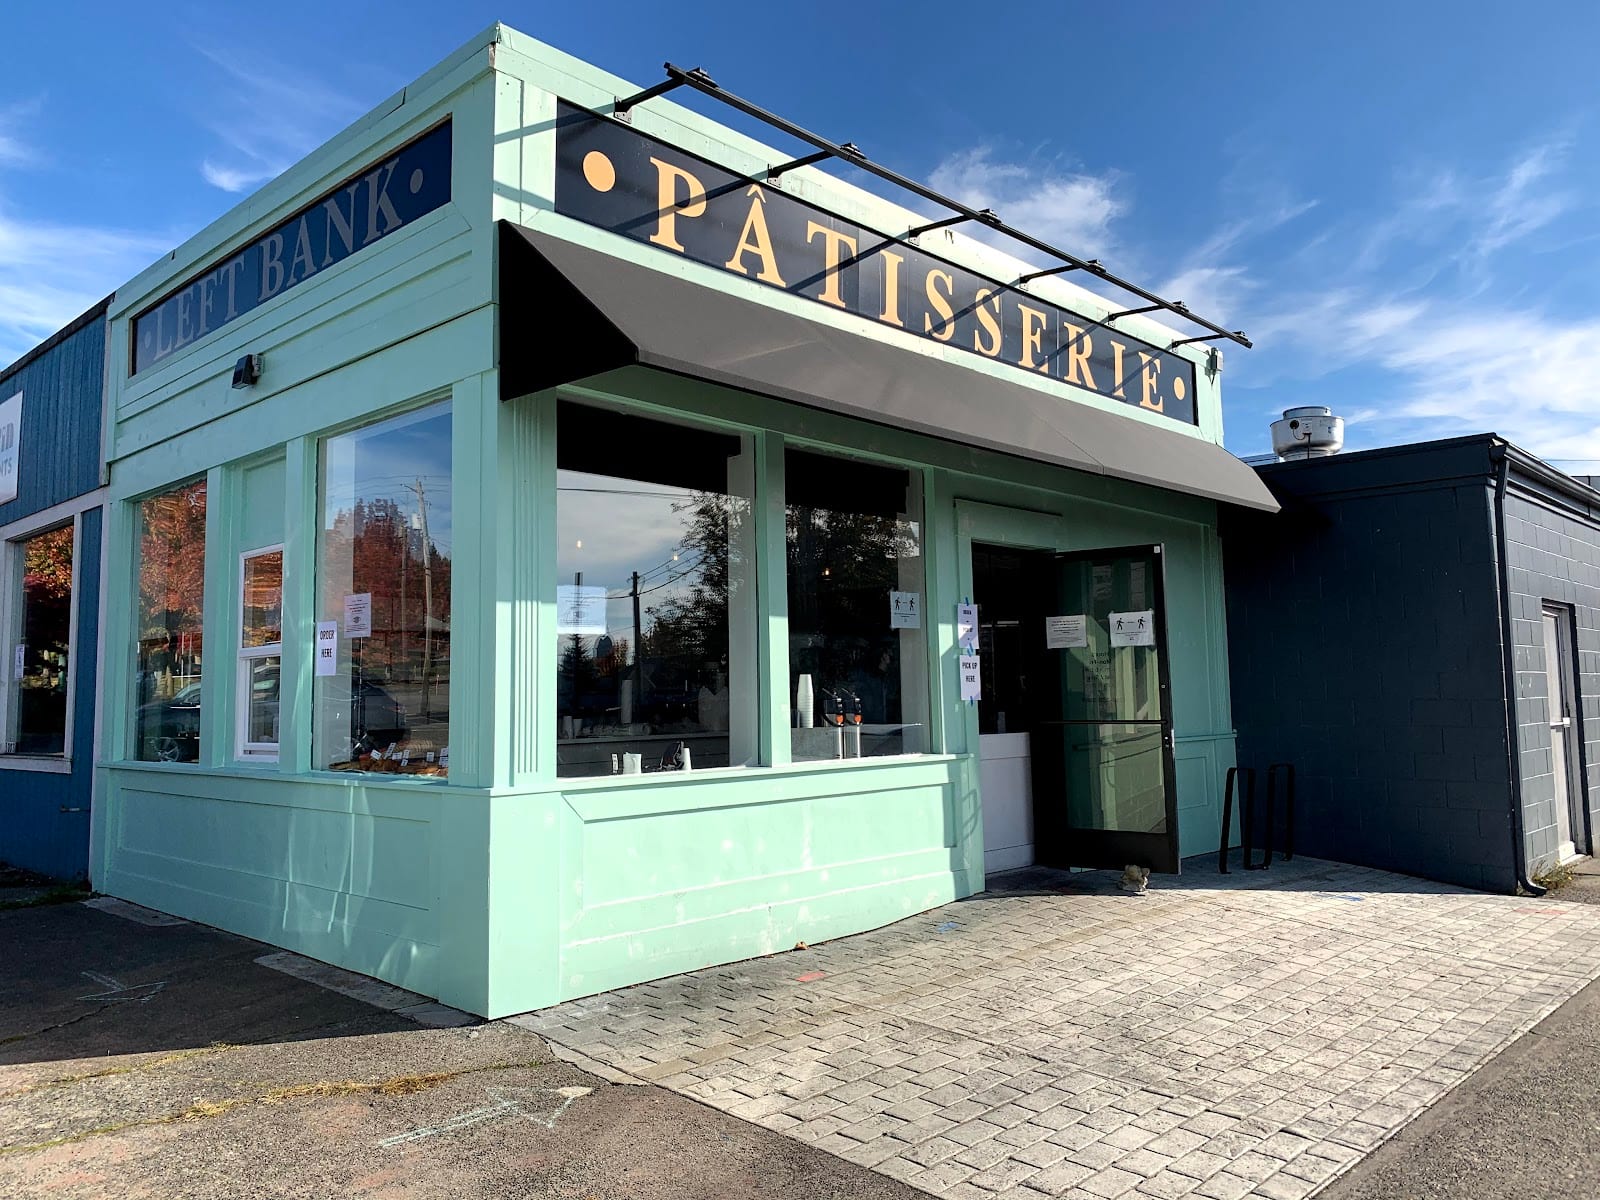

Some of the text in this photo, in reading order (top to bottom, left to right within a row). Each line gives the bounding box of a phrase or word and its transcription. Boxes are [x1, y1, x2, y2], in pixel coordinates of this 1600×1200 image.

[153, 158, 403, 361] LEFT BANK
[649, 156, 1164, 413] PÂTISSERIE
[320, 630, 335, 640] ORDER
[321, 648, 333, 658] HERE
[962, 662, 971, 670] PICK
